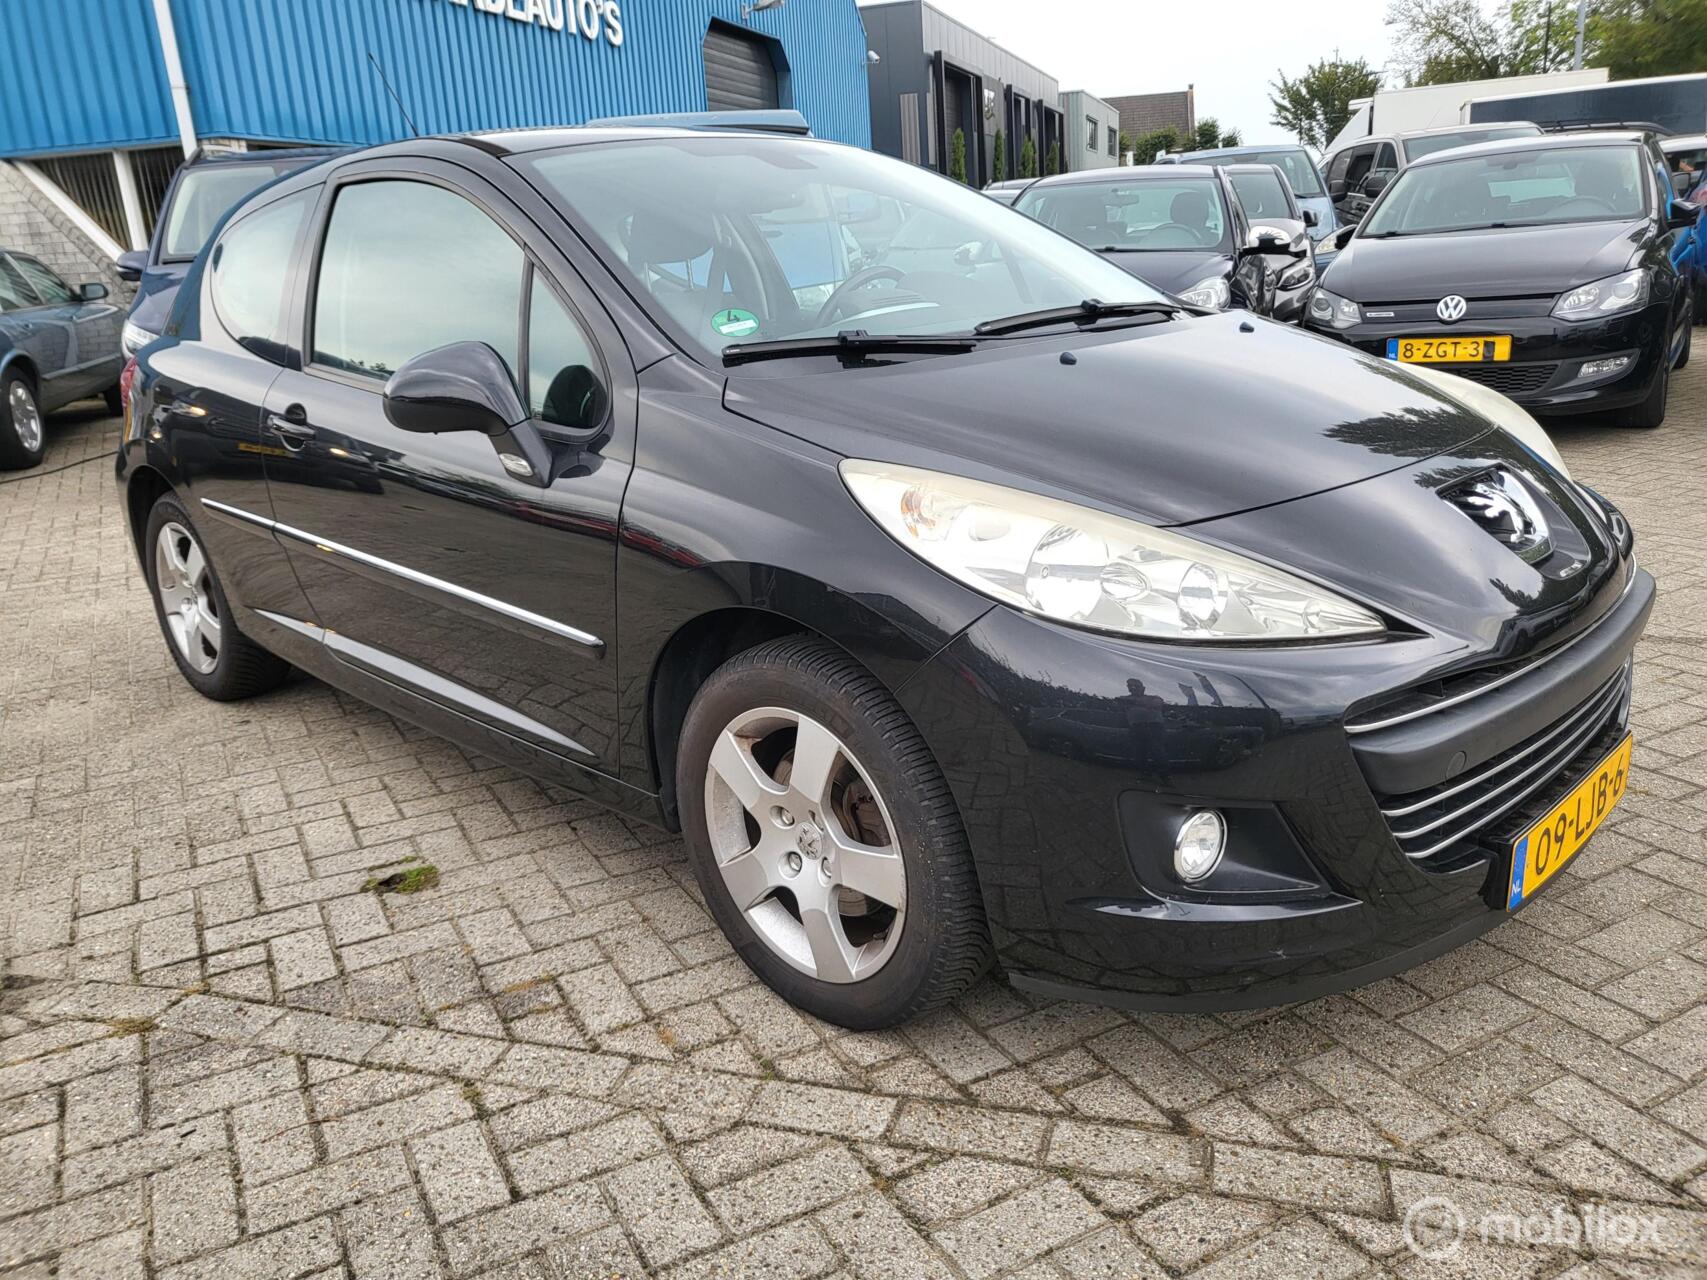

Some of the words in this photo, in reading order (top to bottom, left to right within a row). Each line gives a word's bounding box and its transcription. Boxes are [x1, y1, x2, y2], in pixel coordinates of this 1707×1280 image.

[447, 0, 624, 47] AUTO'S
[1403, 341, 1495, 359] 8-ZGT-3
[1535, 753, 1624, 876] 09-LJB-6
[1511, 879, 1521, 896] NL
